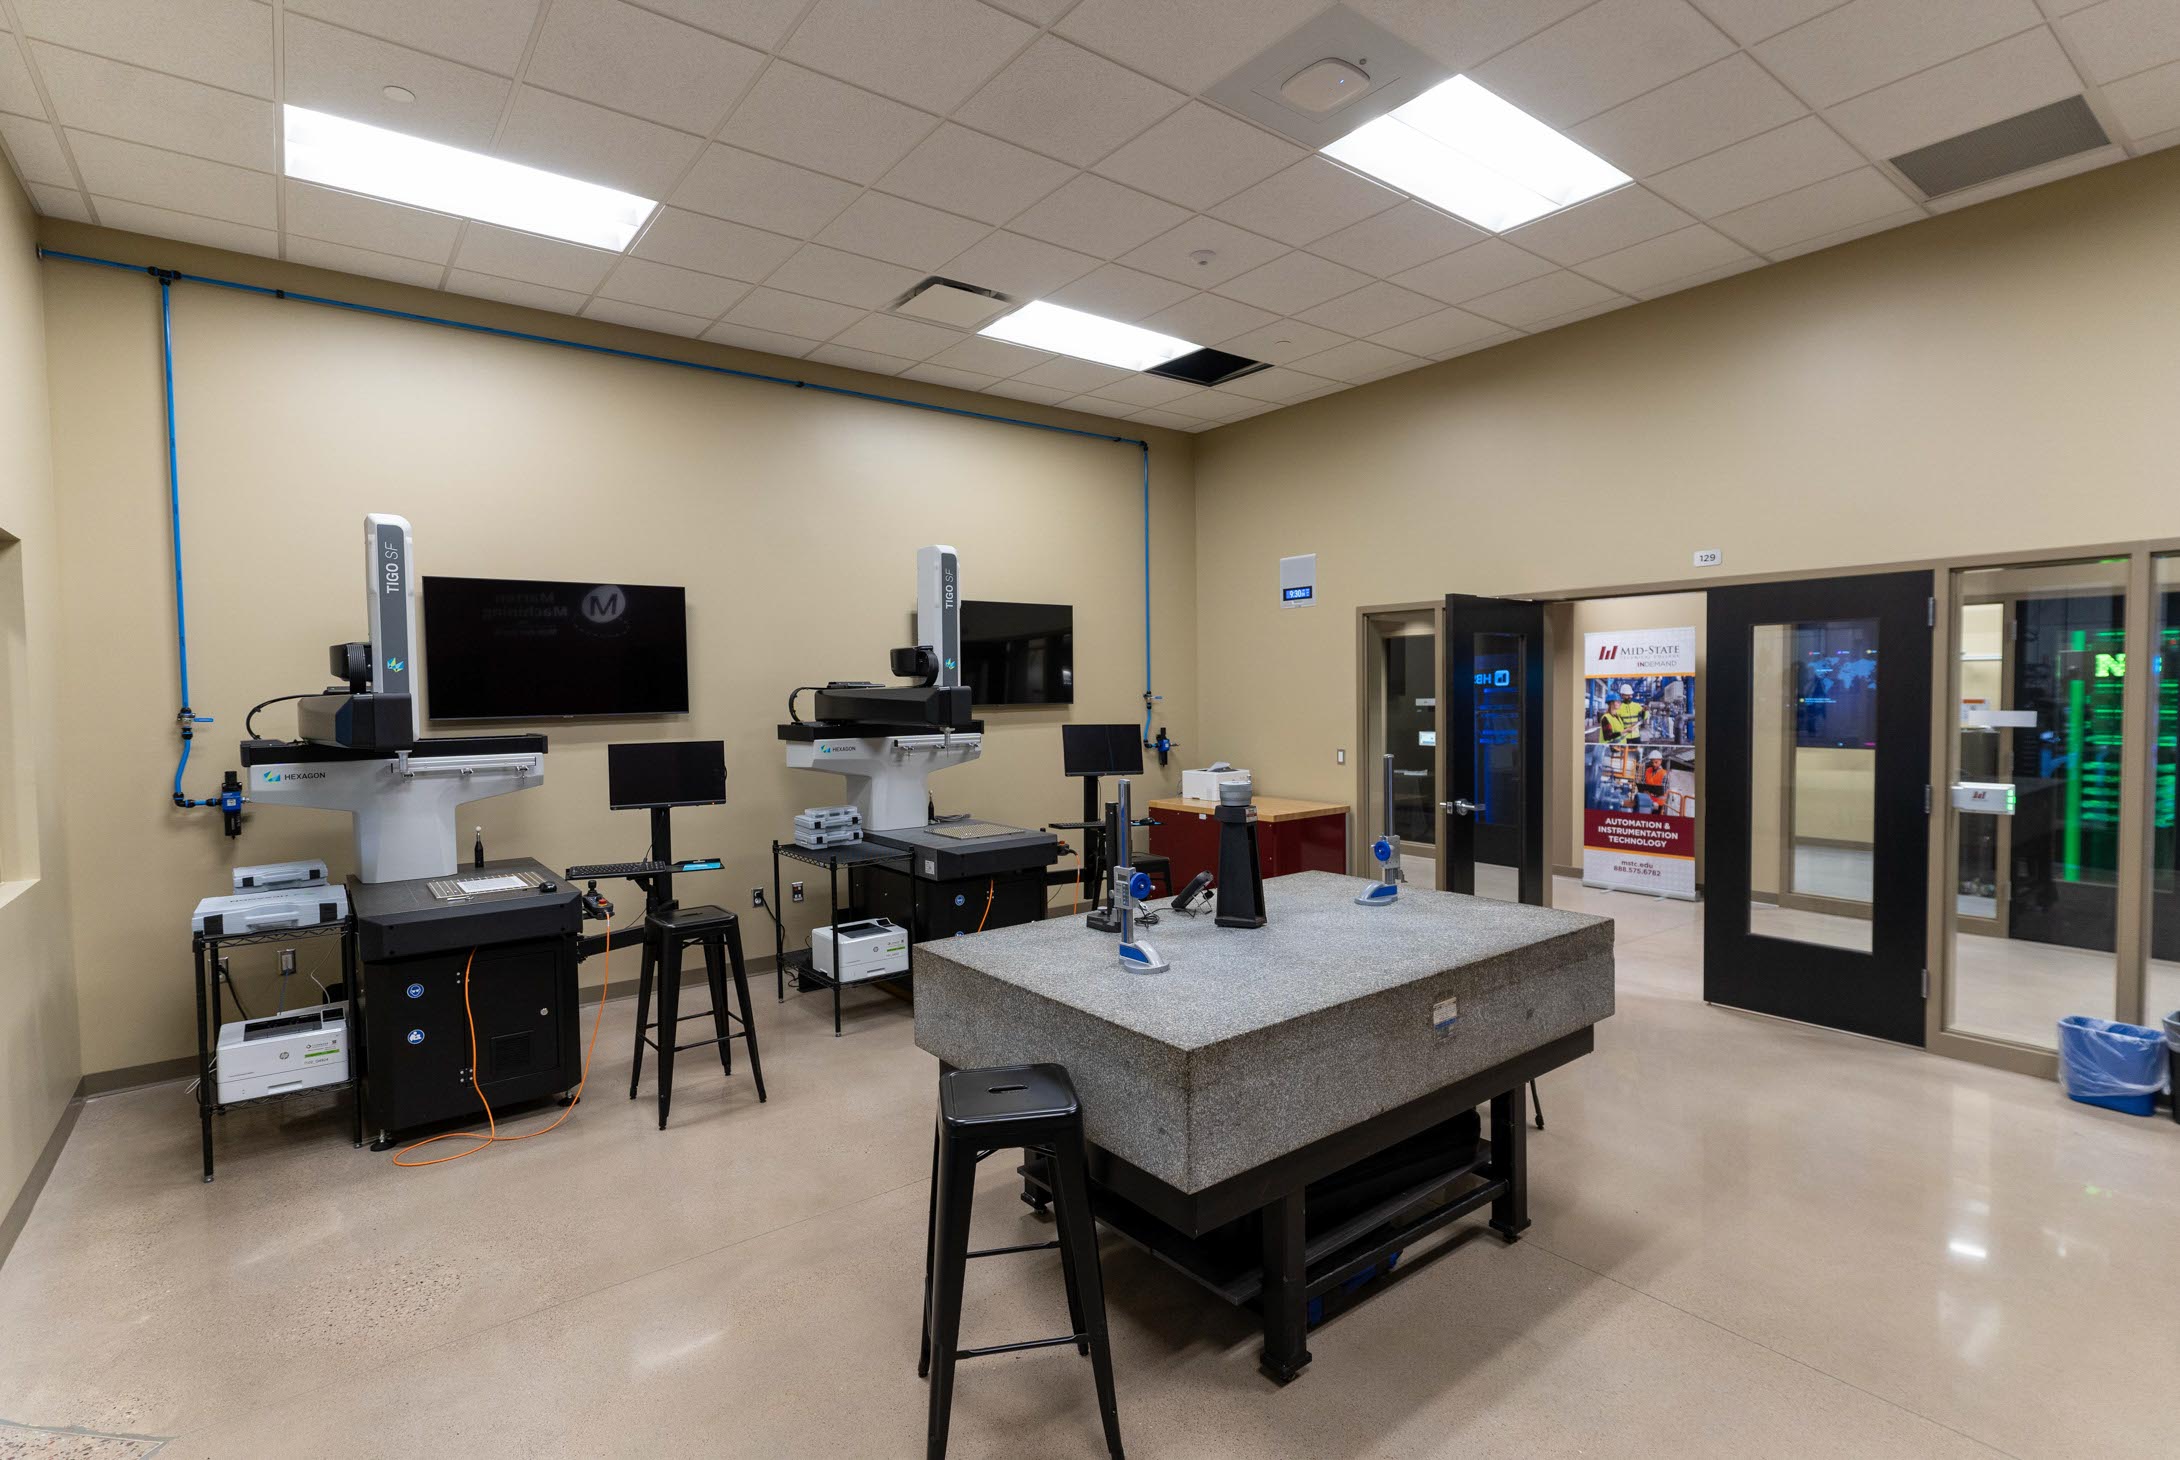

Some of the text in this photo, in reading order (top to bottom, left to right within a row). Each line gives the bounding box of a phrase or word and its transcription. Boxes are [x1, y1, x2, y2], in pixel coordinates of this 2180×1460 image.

[1699, 553, 1716, 562] 129
[384, 541, 399, 594] TIGO SF
[945, 568, 954, 609] TIGO SF
[1620, 645, 1680, 656] MID-STATE
[1637, 660, 1677, 668] INDEMAND
[284, 772, 326, 781] HEXAGON
[1605, 818, 1671, 830] AUTOMATION &
[1598, 826, 1679, 840] INSTRUMENTATION
[1608, 835, 1667, 848] TECHNOLOGY
[1621, 860, 1654, 869] mstc.edu
[1613, 865, 1661, 877] 888.575.6782
